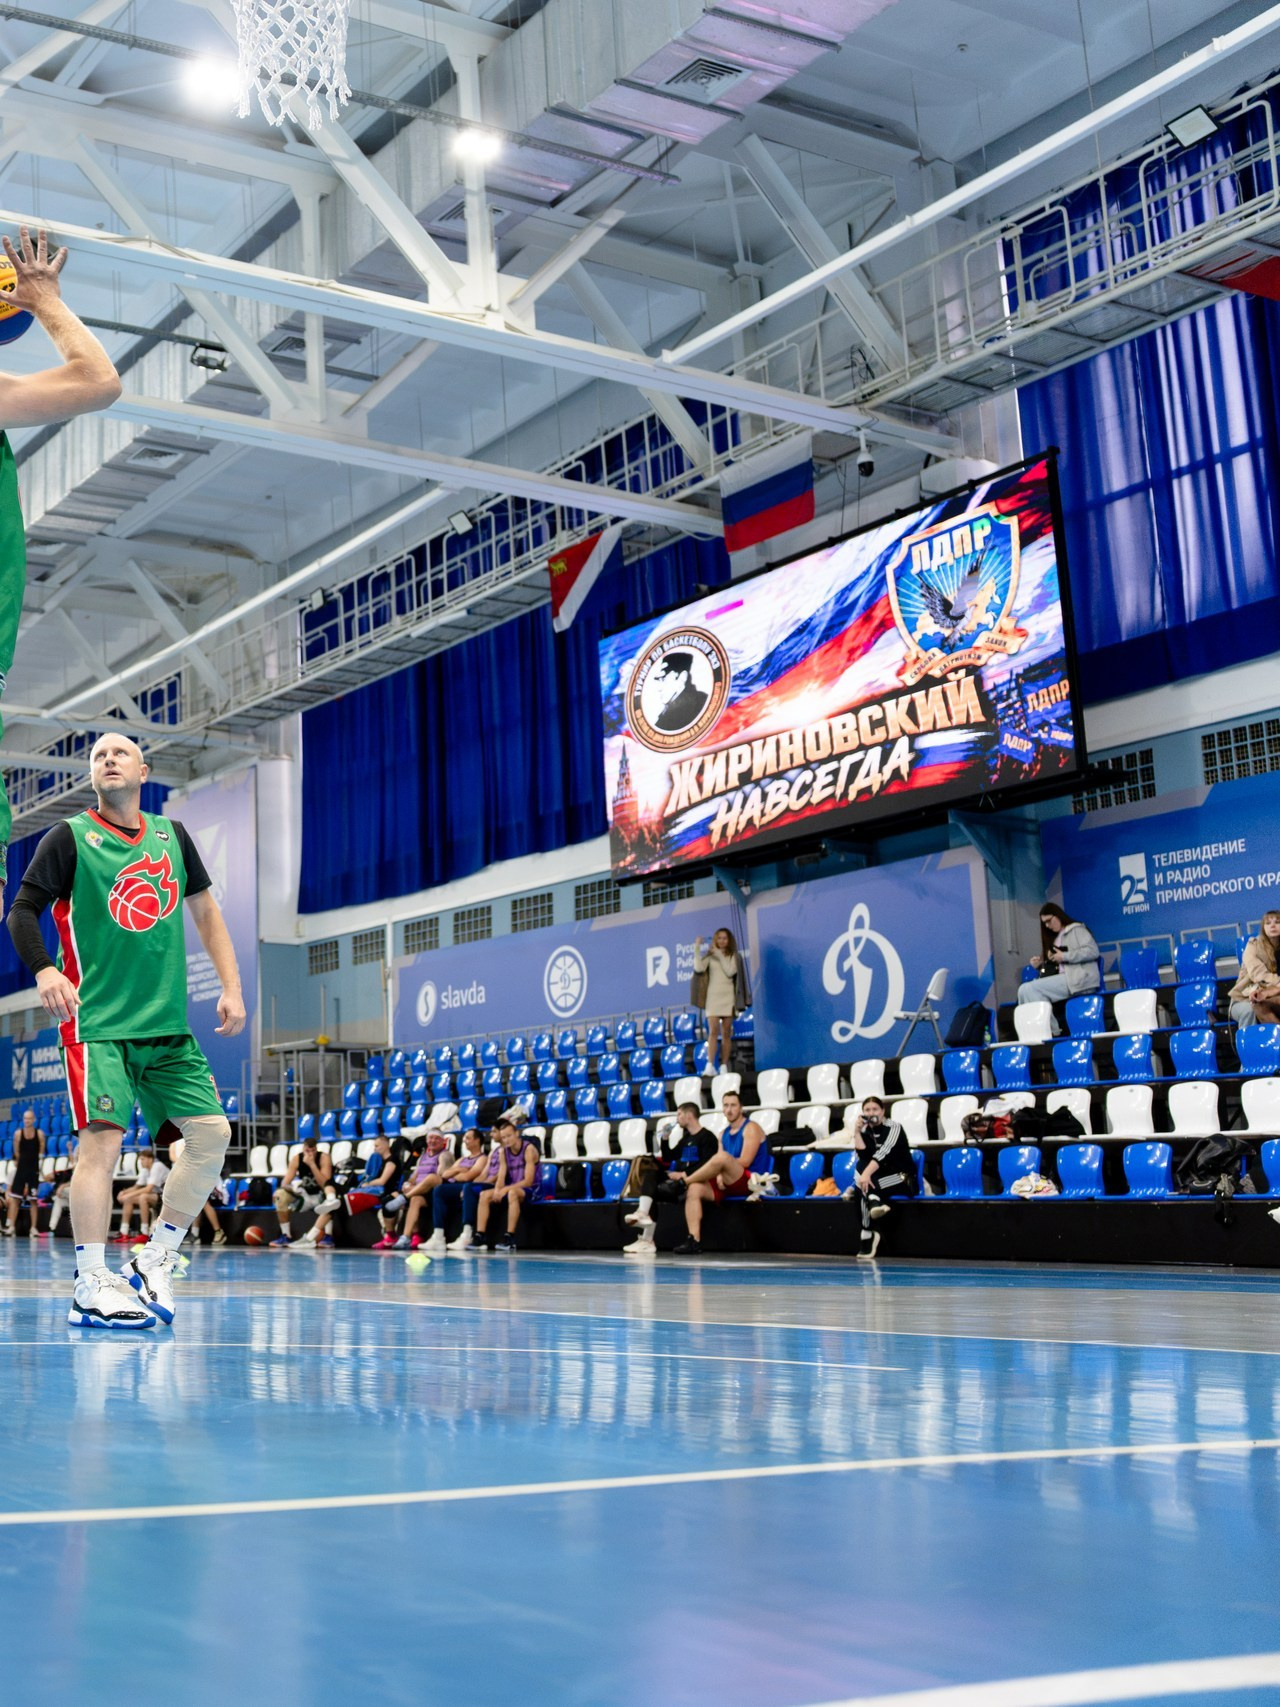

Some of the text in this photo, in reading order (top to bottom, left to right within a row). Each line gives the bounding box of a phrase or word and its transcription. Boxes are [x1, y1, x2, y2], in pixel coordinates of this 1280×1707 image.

[910, 517, 992, 576] ЛДПР
[1026, 678, 1071, 714] ЛДПР
[663, 669, 987, 818] ЖИРИНОВСКИЙ
[1002, 732, 1033, 753] ЛДПР
[707, 735, 917, 850] НАВСЕГДА
[1152, 838, 1247, 868] ТЕЛЕВИДЕНИЕ
[1154, 864, 1211, 887] И РАДИО
[1155, 876, 1255, 905] ПРИМОРСКОГО
[1122, 902, 1150, 915] РЕГИОН
[440, 980, 487, 1010] slavda
